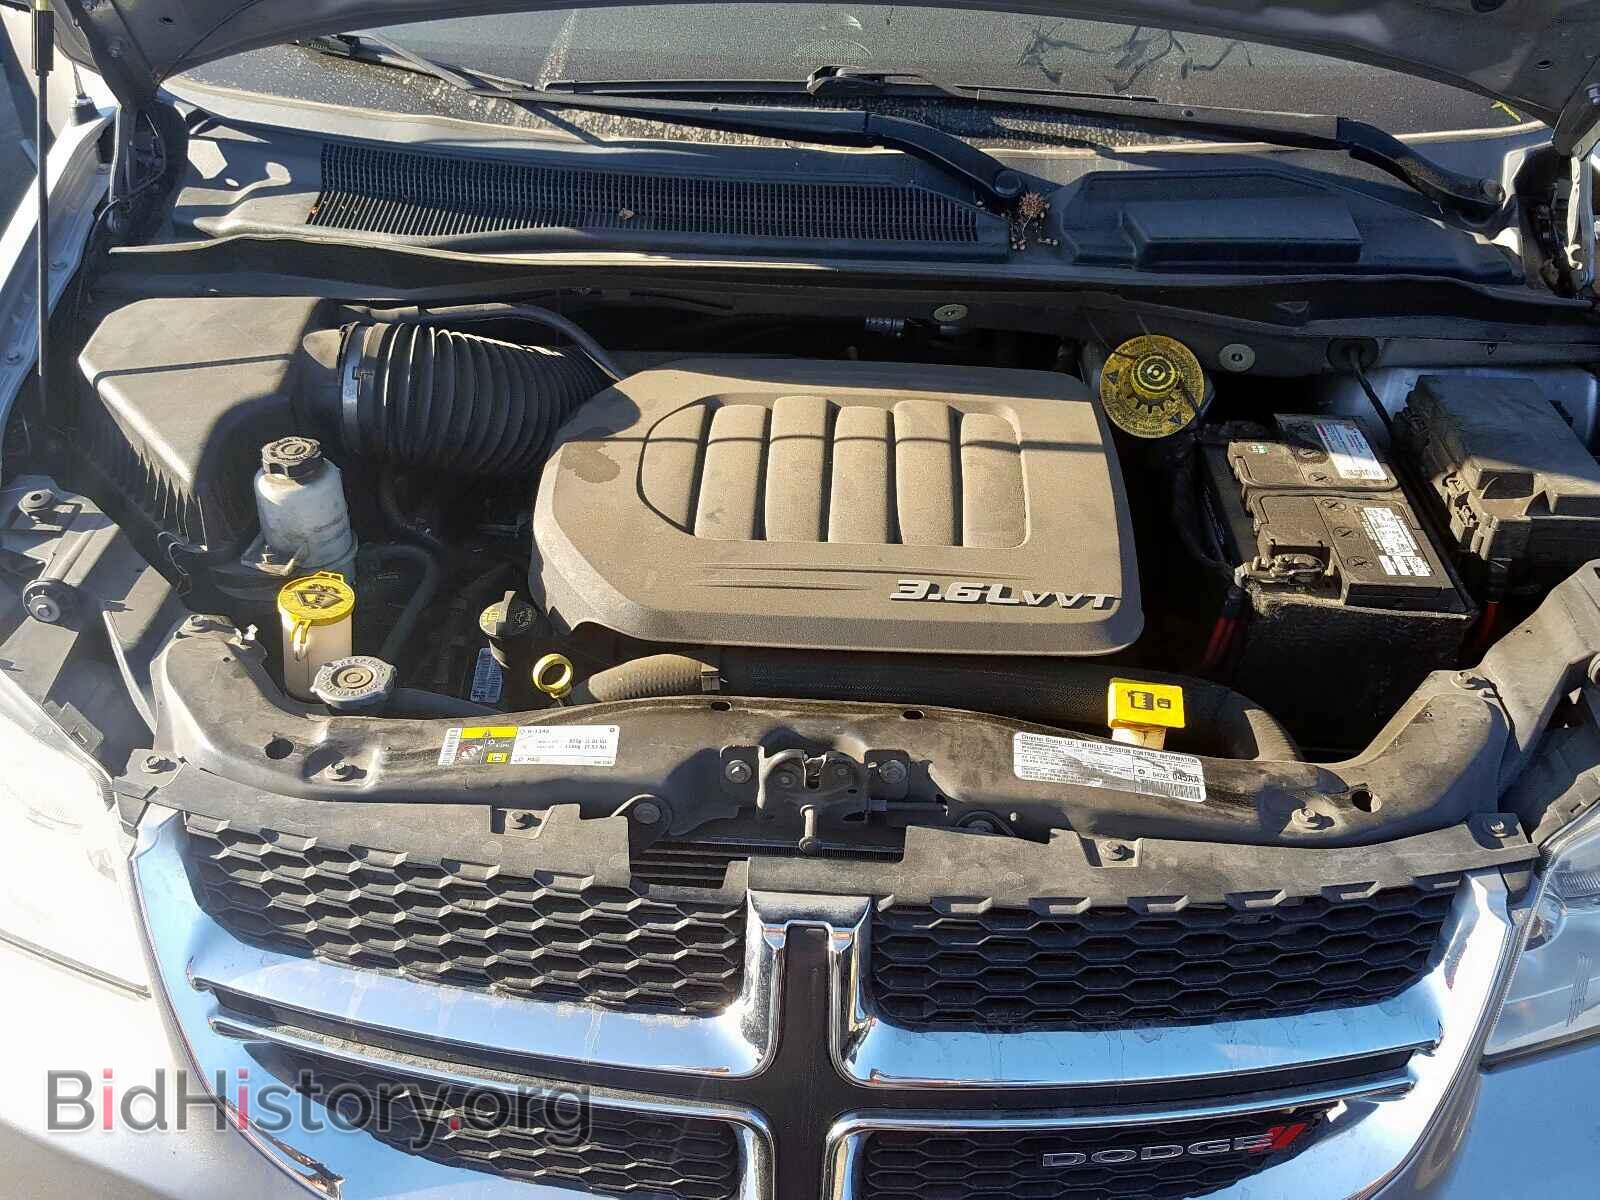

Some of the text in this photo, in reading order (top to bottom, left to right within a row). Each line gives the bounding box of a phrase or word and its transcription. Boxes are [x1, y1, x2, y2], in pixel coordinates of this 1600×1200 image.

[1132, 749, 1158, 759] CONTROL
[1159, 753, 1198, 764] INFORMATION
[1042, 1133, 1274, 1167] DODGE
